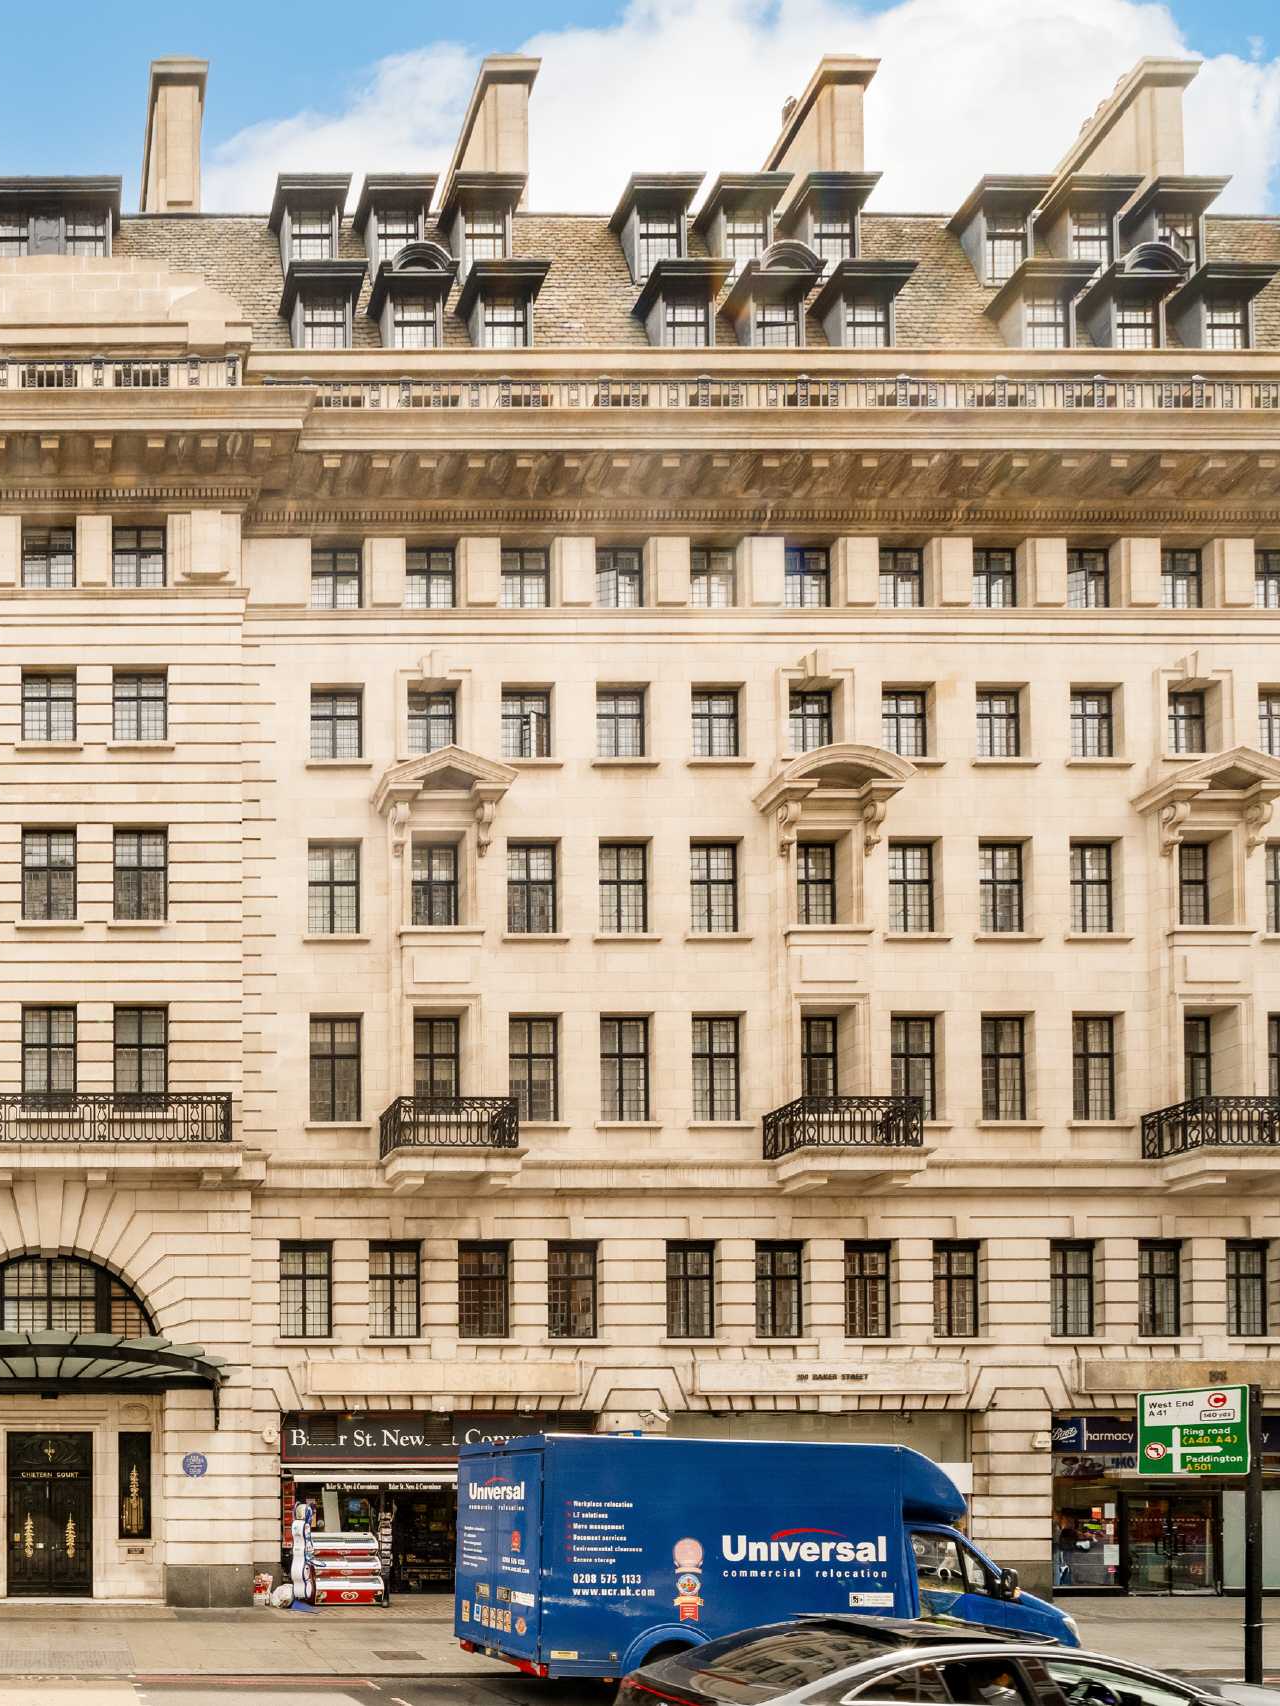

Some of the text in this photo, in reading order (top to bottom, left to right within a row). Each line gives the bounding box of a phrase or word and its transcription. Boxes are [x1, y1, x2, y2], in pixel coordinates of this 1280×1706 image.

[812, 1373, 838, 1381] BAKER
[841, 1373, 869, 1381] STREET
[1148, 1401, 1172, 1409] West
[1086, 1430, 1134, 1443] harmacy
[1183, 1427, 1231, 1437] Ring road
[353, 1429, 377, 1447] St.
[1215, 1435, 1238, 1444] A4)
[1186, 1456, 1243, 1464] Paddington
[1186, 1463, 1212, 1471] A501
[469, 1481, 525, 1500] Universal
[573, 1500, 602, 1508] Workplace
[722, 1535, 887, 1562] Universal
[723, 1568, 887, 1578] commercial relocation
[573, 1573, 641, 1584] 0208 575 1133
[572, 1587, 656, 1597] www.ucr.uk.com
